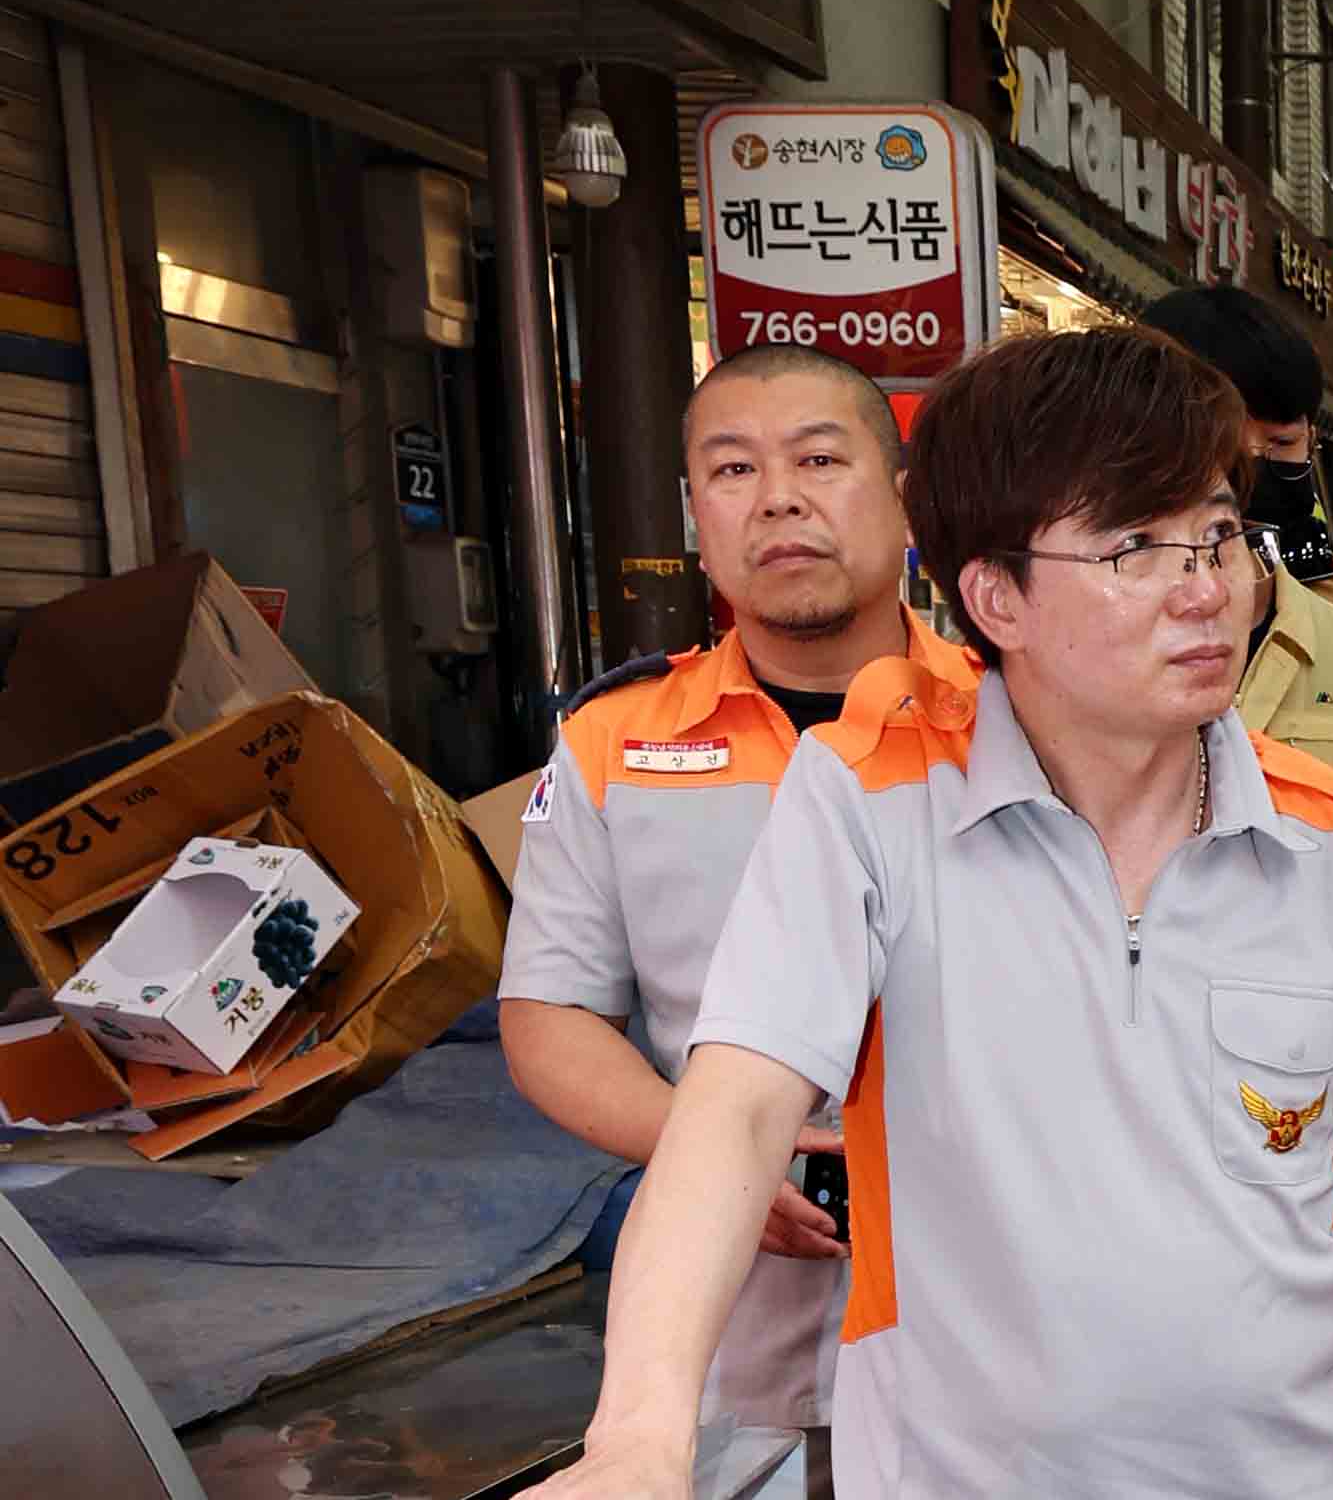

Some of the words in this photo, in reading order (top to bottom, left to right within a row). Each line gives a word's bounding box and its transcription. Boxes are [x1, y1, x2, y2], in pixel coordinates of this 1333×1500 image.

[772, 136, 867, 165] 송현시장
[719, 197, 948, 262] 해뜨는식품
[739, 310, 941, 347] 766-0960
[408, 464, 436, 499] 22
[4, 802, 122, 881] 128
